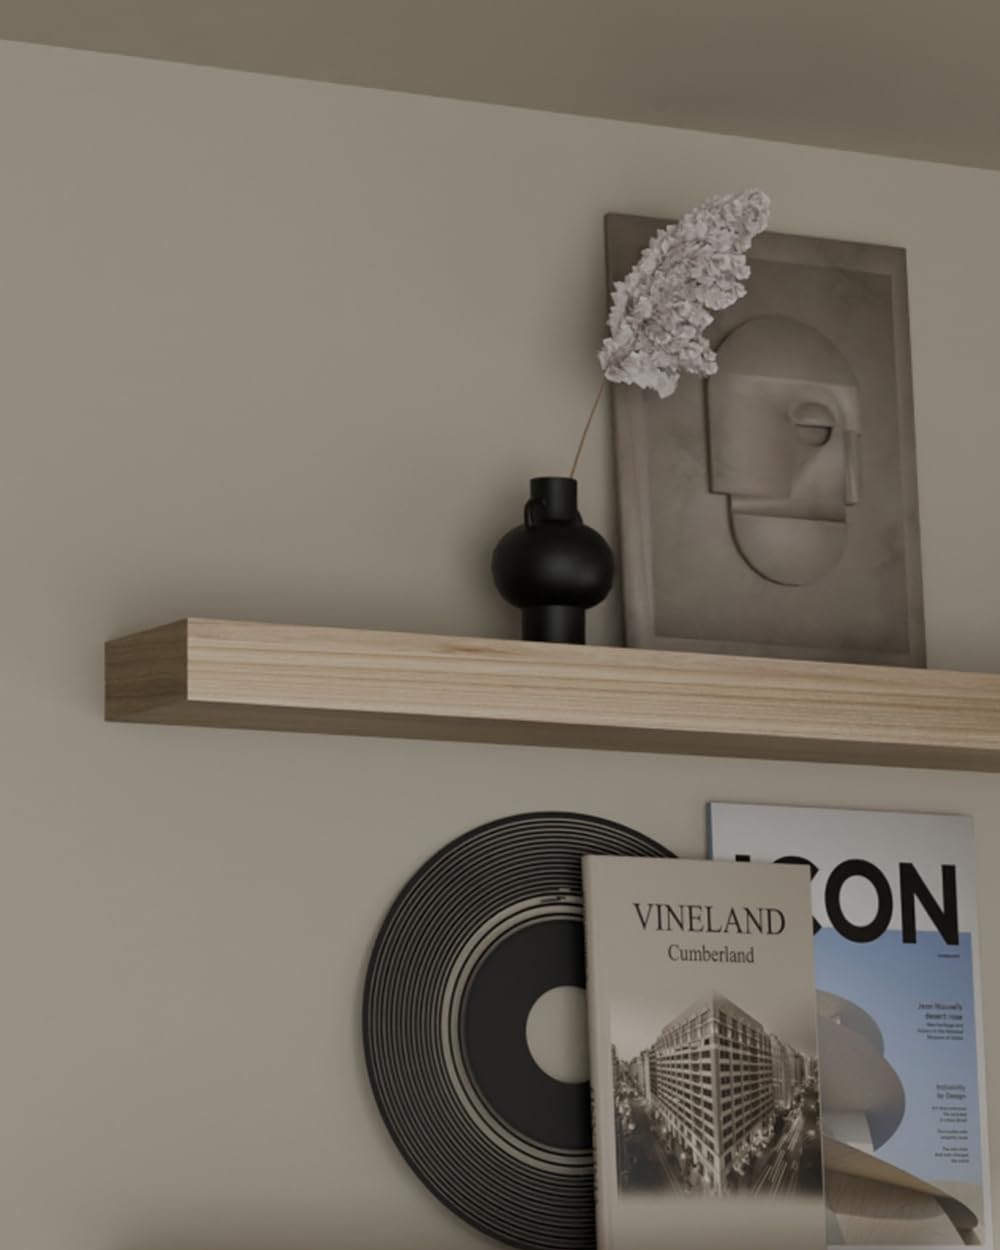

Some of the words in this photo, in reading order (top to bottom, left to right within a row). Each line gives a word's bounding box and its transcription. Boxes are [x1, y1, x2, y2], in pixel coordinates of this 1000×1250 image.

[735, 854, 959, 945] ON
[632, 902, 786, 936] VINELAND
[667, 943, 755, 964] Cumberland
